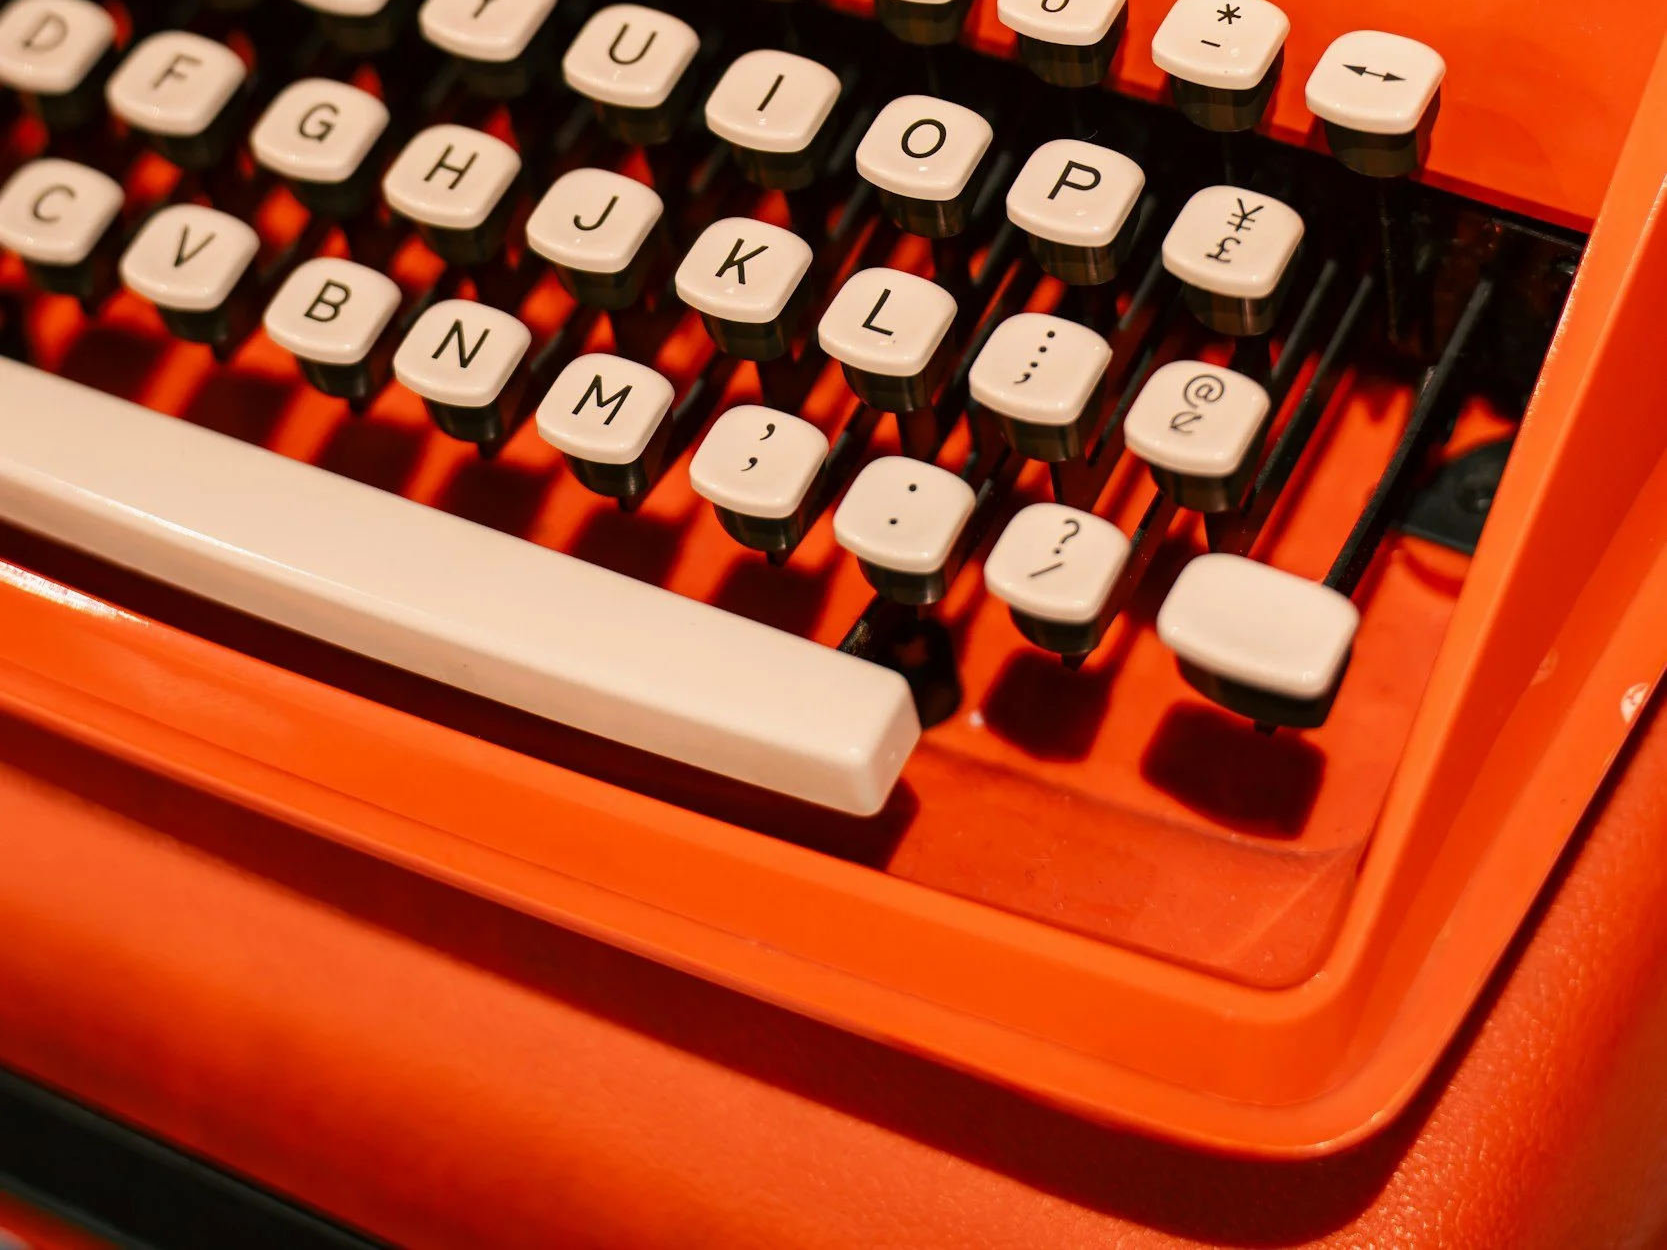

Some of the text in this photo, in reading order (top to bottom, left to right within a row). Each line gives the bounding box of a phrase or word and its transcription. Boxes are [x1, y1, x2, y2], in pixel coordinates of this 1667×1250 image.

[21, 11, 69, 54] D
[607, 23, 658, 66] U
[152, 53, 203, 91] F
[756, 74, 785, 112] I
[297, 102, 340, 143] G
[900, 118, 947, 159] O
[423, 144, 478, 190] H
[1046, 160, 1102, 201] P
[31, 184, 77, 225] C
[572, 195, 619, 232] J
[1226, 197, 1265, 233] ¥
[173, 226, 217, 269] V
[714, 237, 769, 286] K
[1204, 236, 1242, 264] £
[303, 279, 352, 323] B
[861, 288, 894, 337] L
[431, 319, 491, 369] N
[571, 374, 633, 426] M
[1182, 373, 1226, 409] @
[1052, 518, 1082, 556] ?
